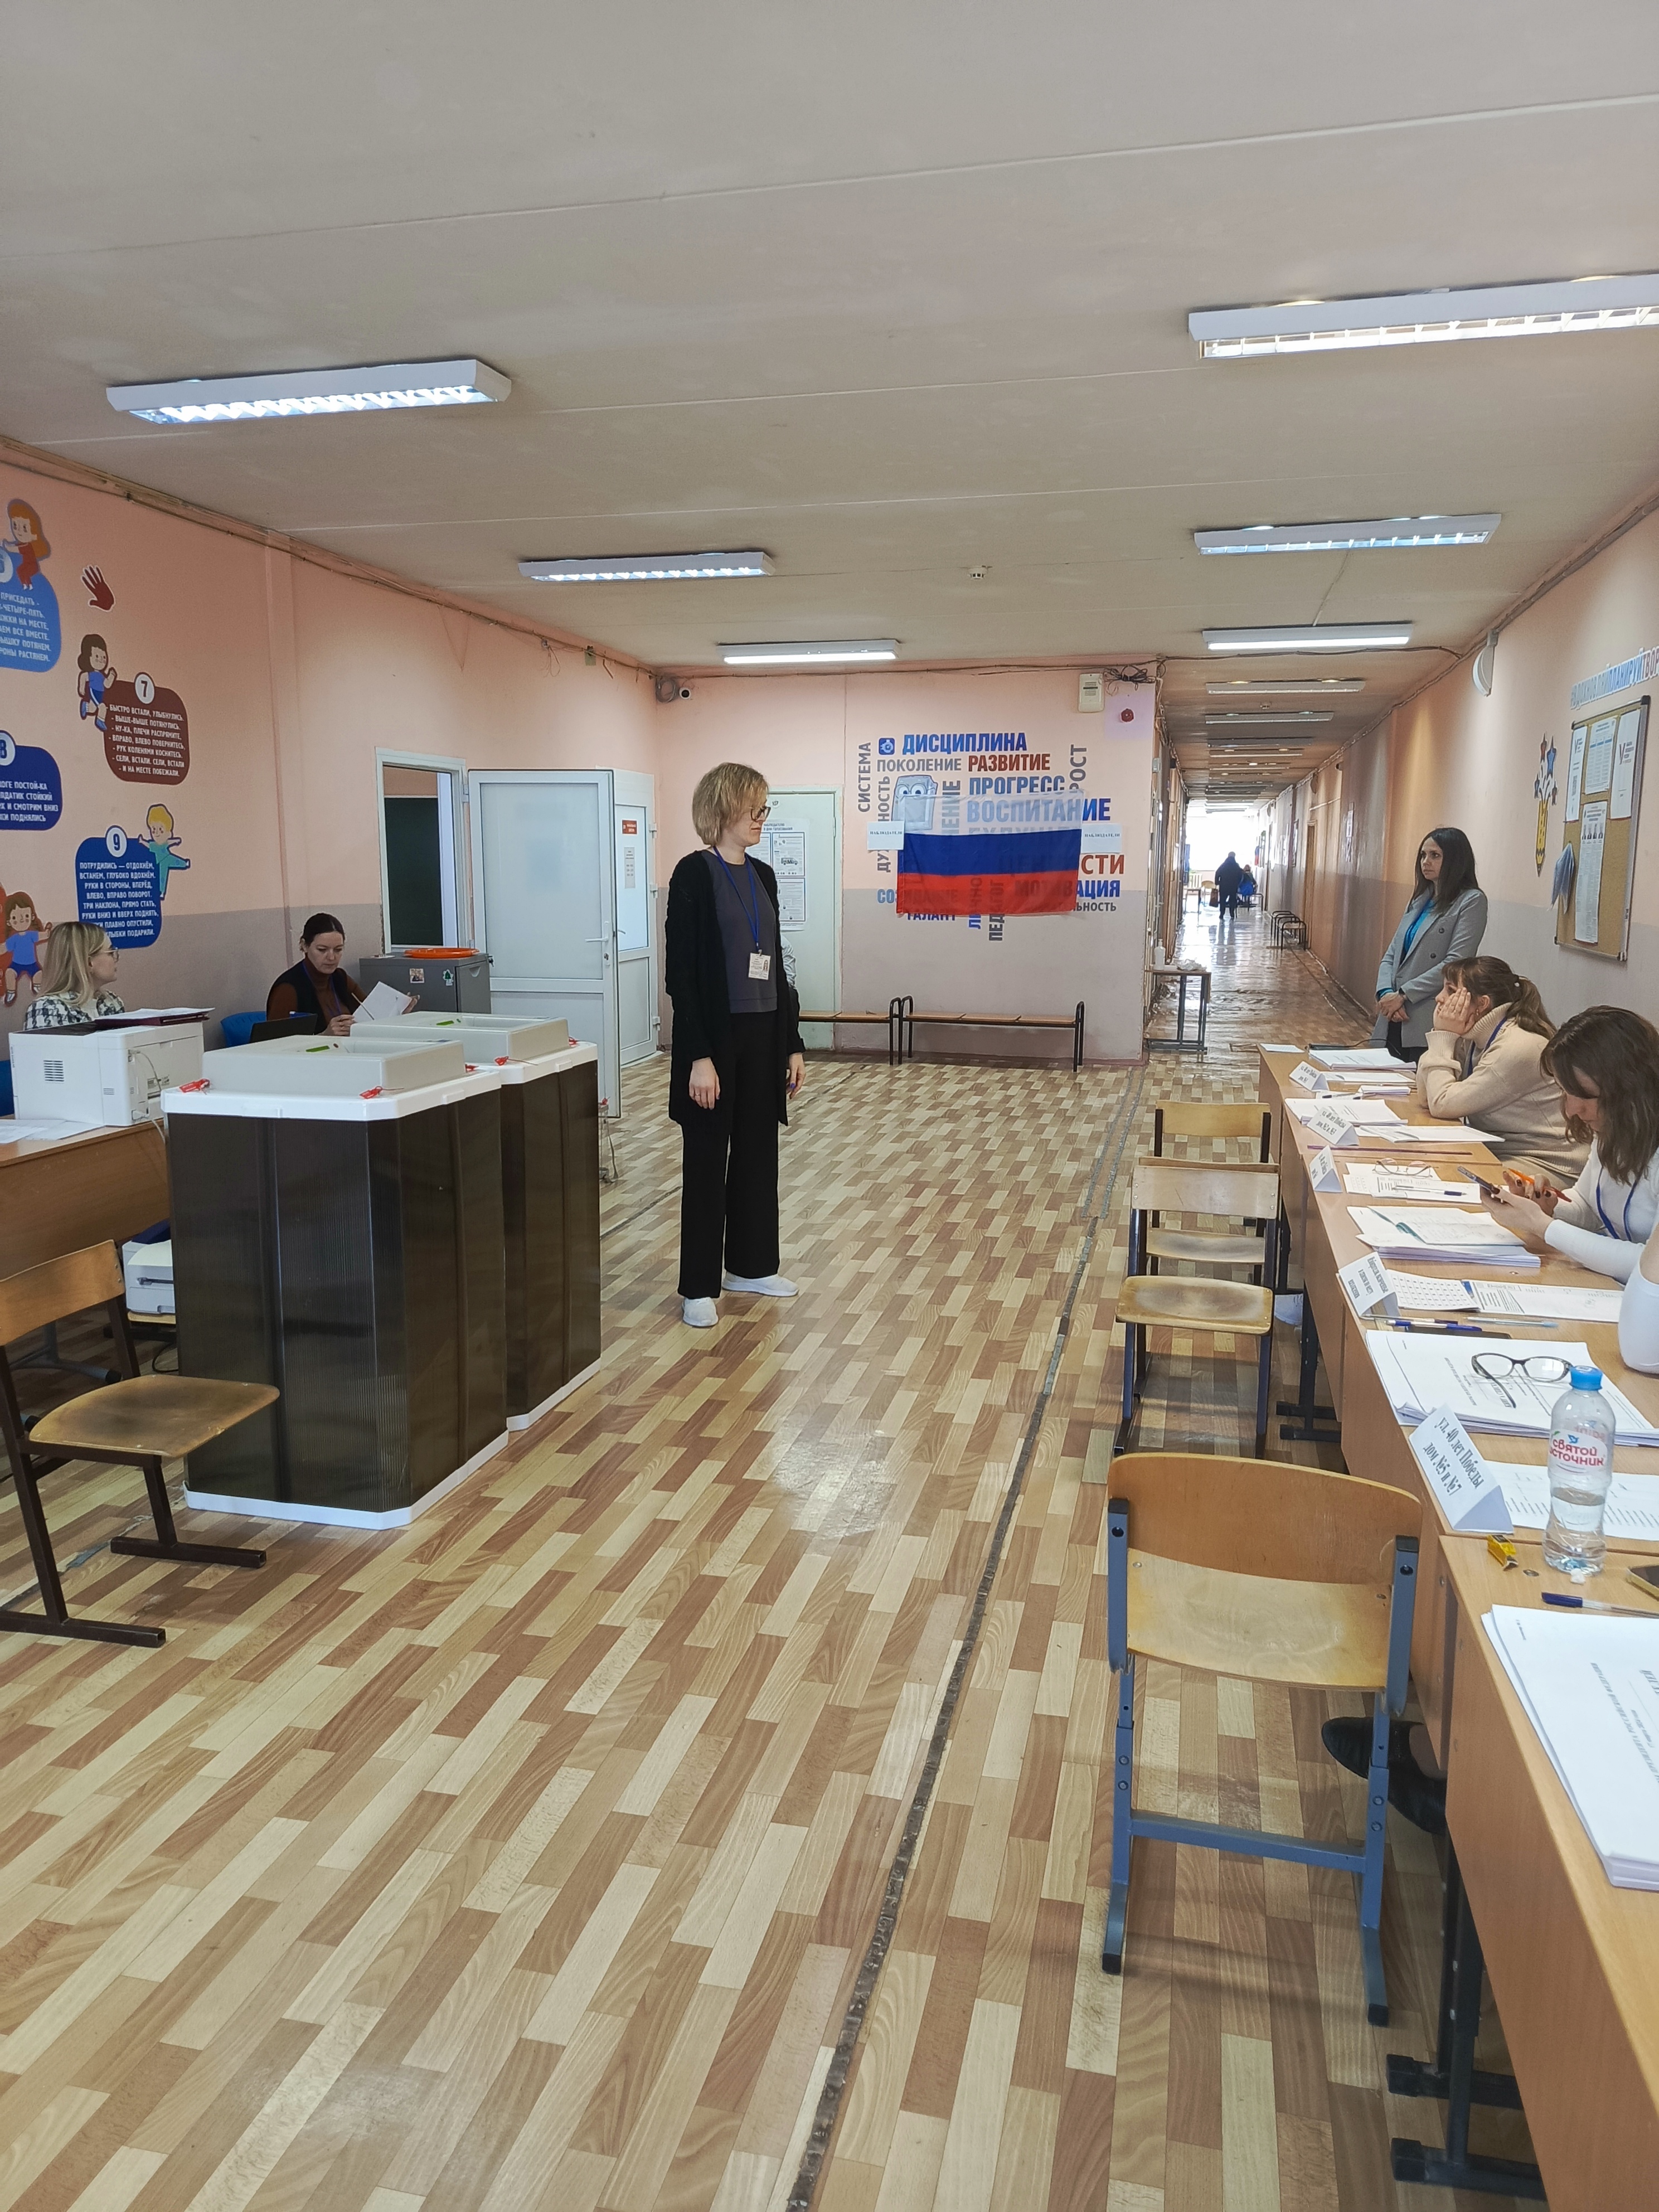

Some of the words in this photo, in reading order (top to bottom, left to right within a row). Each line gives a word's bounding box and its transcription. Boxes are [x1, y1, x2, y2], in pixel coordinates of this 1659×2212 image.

[1, 593, 35, 605] ПРИСЕДАТЬ
[13, 628, 23, 637] ВСЕ
[141, 680, 148, 697] 7
[110, 704, 130, 713] БЫСТРО
[134, 727, 150, 736] ПЛЕЧИ
[128, 746, 154, 755] КОЛЕНЯМИ
[903, 733, 1027, 755] ДИСЦИПЛИНА
[877, 758, 962, 772] ПОКОЛЕНИЕ
[968, 754, 1050, 772] РАЗВИТИЕ
[1069, 744, 1086, 792] РОСТ
[14, 780, 47, 790] ПОСТОЙ-КА
[858, 742, 871, 812] СИСТЕМА
[969, 775, 1065, 795] ПРОГРЕСС
[26, 792, 52, 801] СТОЙКИЙ
[11, 813, 46, 822] ПОДНЯЛИСЬ
[967, 798, 1111, 823] ВОСПИТАНИЕ
[113, 833, 120, 851] 9
[1434, 1417, 1449, 1434] ул.
[1446, 1428, 1459, 1443] 40
[1423, 1442, 1439, 1462] дом
[1451, 1439, 1465, 1456] лет
[1553, 1439, 1597, 1456] СВЯТОЙ
[1433, 1455, 1451, 1475] №5
[1459, 1449, 1484, 1489] Победы
[1440, 1472, 1451, 1483] и
[1444, 1476, 1462, 1496] №7
